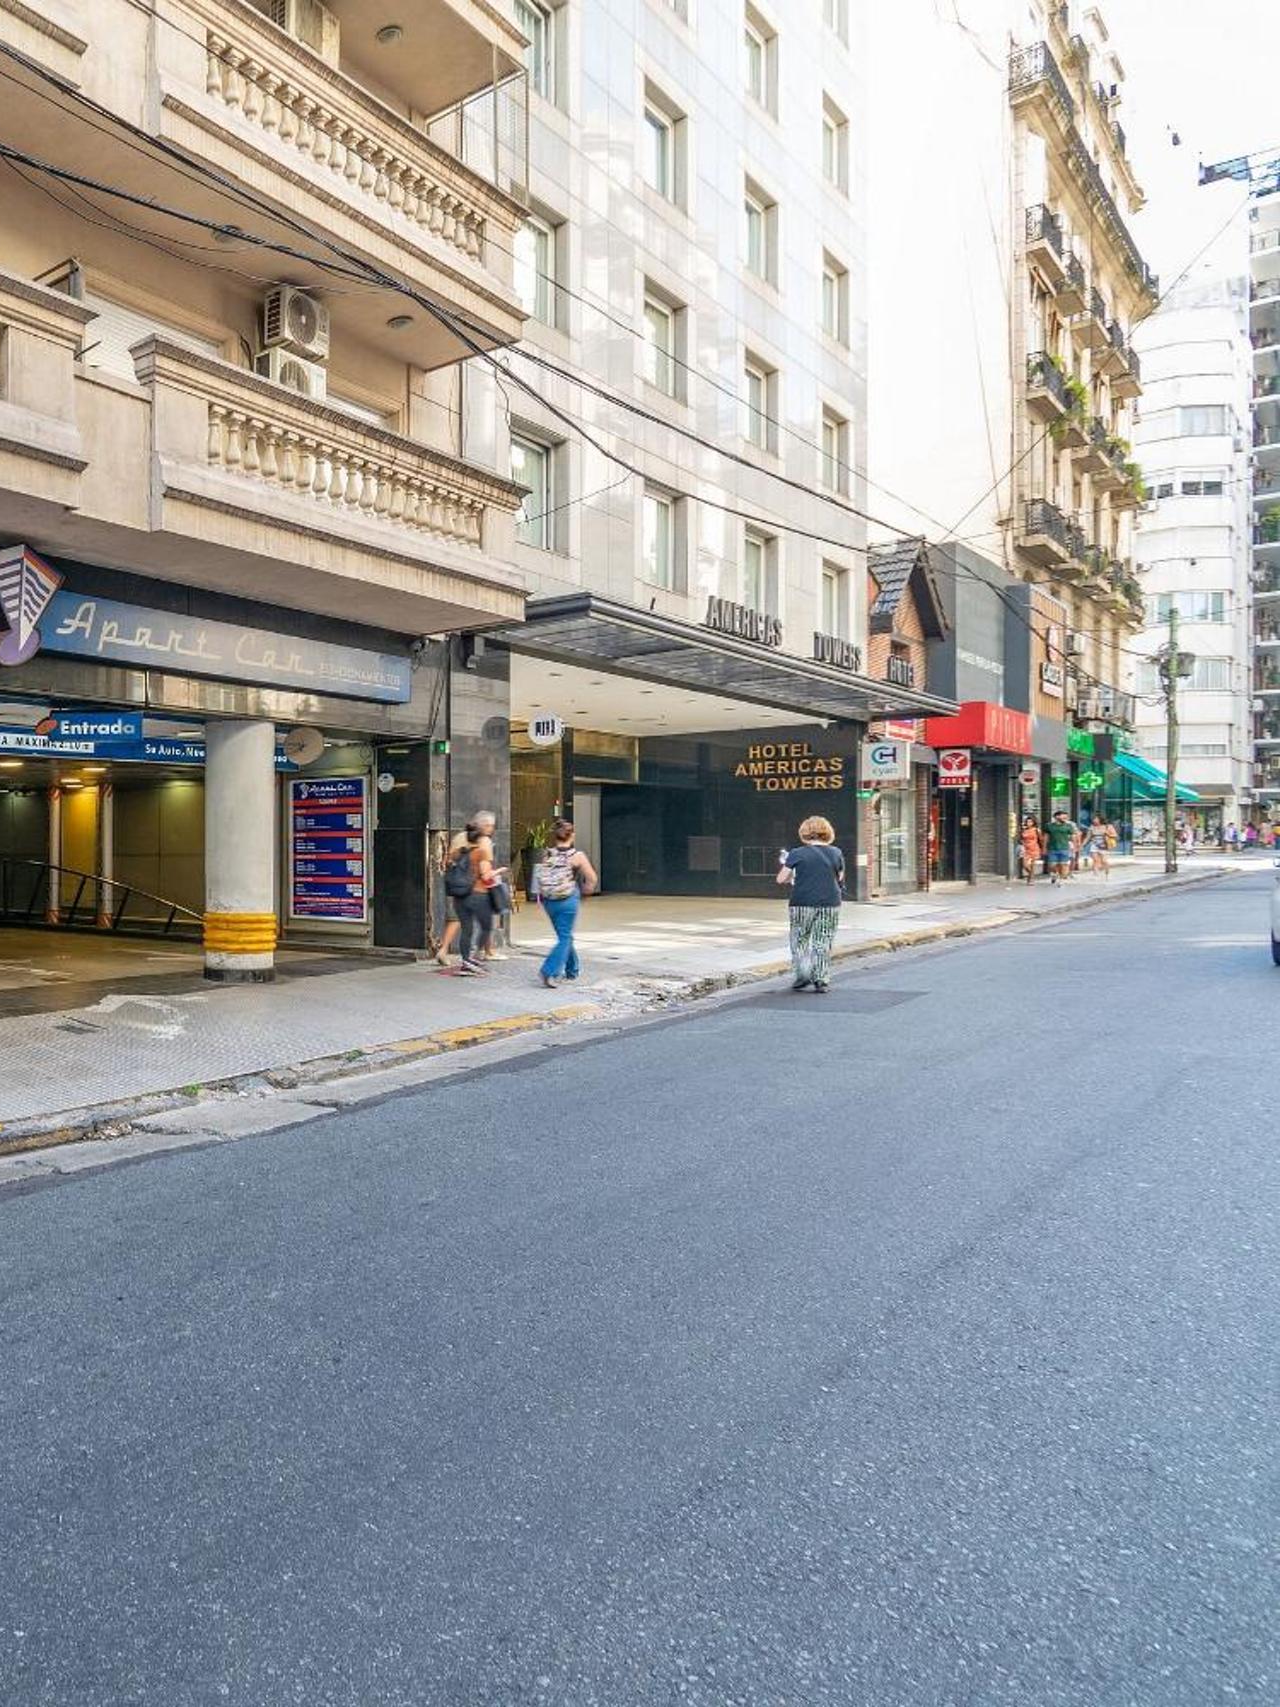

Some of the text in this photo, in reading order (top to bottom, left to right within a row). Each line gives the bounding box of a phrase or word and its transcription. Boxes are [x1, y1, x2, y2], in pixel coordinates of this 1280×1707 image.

[56, 602, 315, 676] Apart Car
[61, 719, 135, 736] Entrada
[749, 743, 813, 759] HOTEL
[735, 757, 843, 776] AMERICAS
[753, 774, 843, 791] TOWERS
